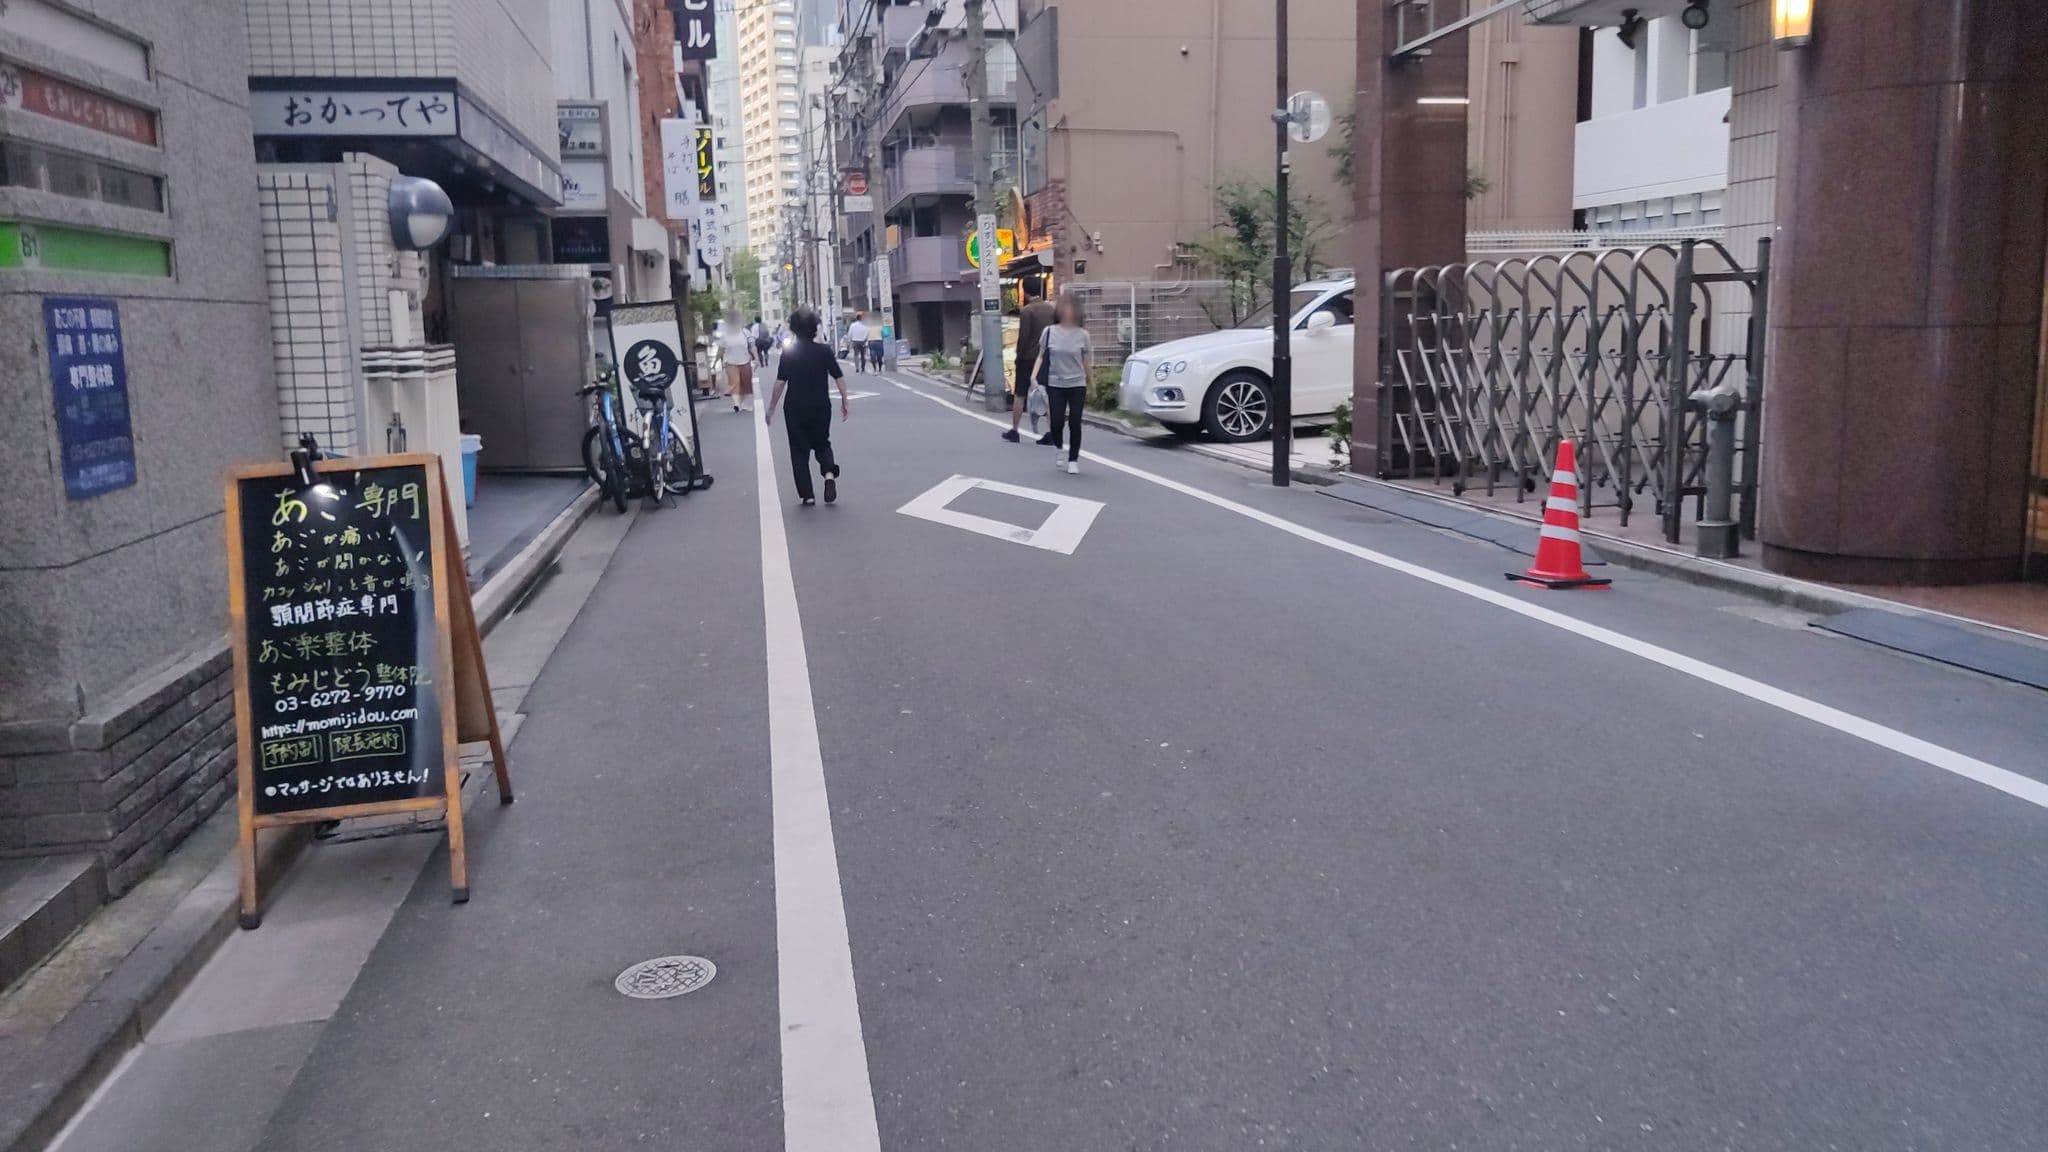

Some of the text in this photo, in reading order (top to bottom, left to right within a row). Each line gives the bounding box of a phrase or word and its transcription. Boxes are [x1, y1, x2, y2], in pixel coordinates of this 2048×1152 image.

[284, 96, 448, 127] おかってや
[21, 231, 39, 257] B1
[705, 207, 718, 257] 株式会社
[272, 482, 420, 526] あご 専門
[275, 685, 406, 712] 03-6272-9770
[261, 708, 418, 739] https://momijidou.com
